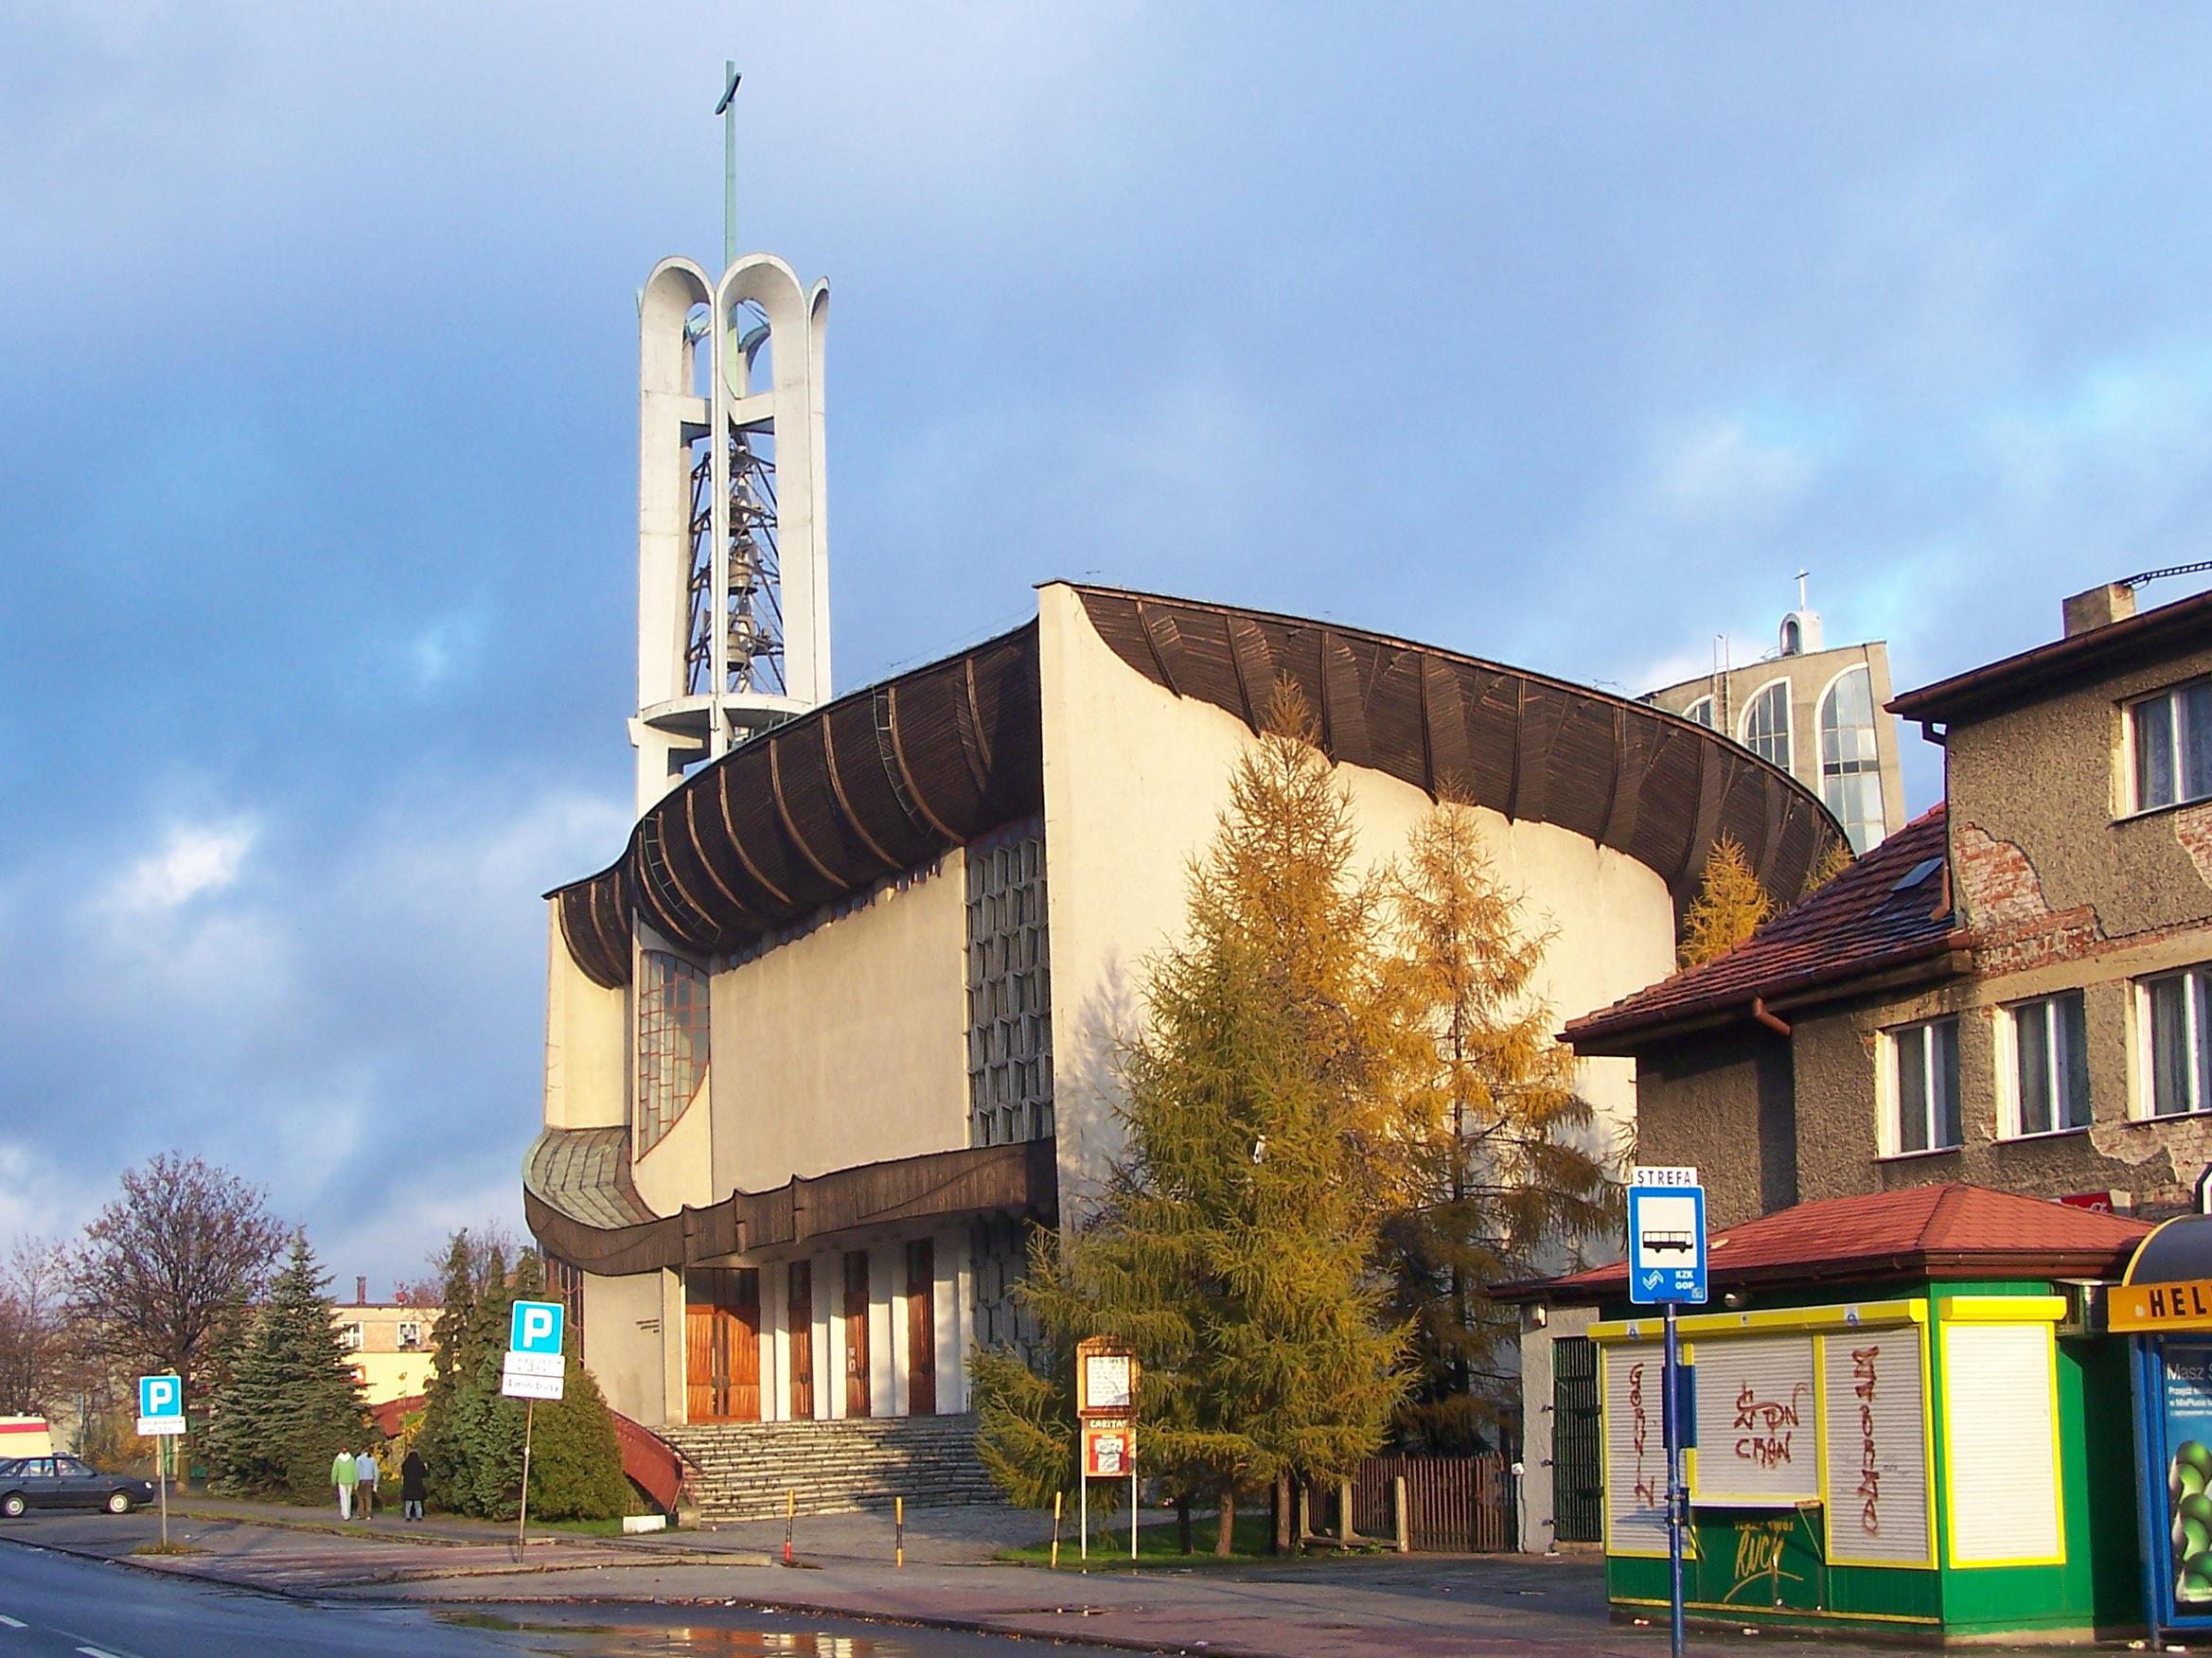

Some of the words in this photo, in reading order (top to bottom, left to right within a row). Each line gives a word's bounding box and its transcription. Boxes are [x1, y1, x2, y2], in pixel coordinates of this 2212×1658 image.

[1637, 1171, 1691, 1185] STREFA
[1674, 1270, 1694, 1279] KZK
[1674, 1281, 1695, 1291] GOP
[2149, 1286, 2212, 1317] HEL
[522, 1308, 554, 1349] P
[2167, 1363, 2205, 1381] Masz
[150, 1381, 173, 1414] P
